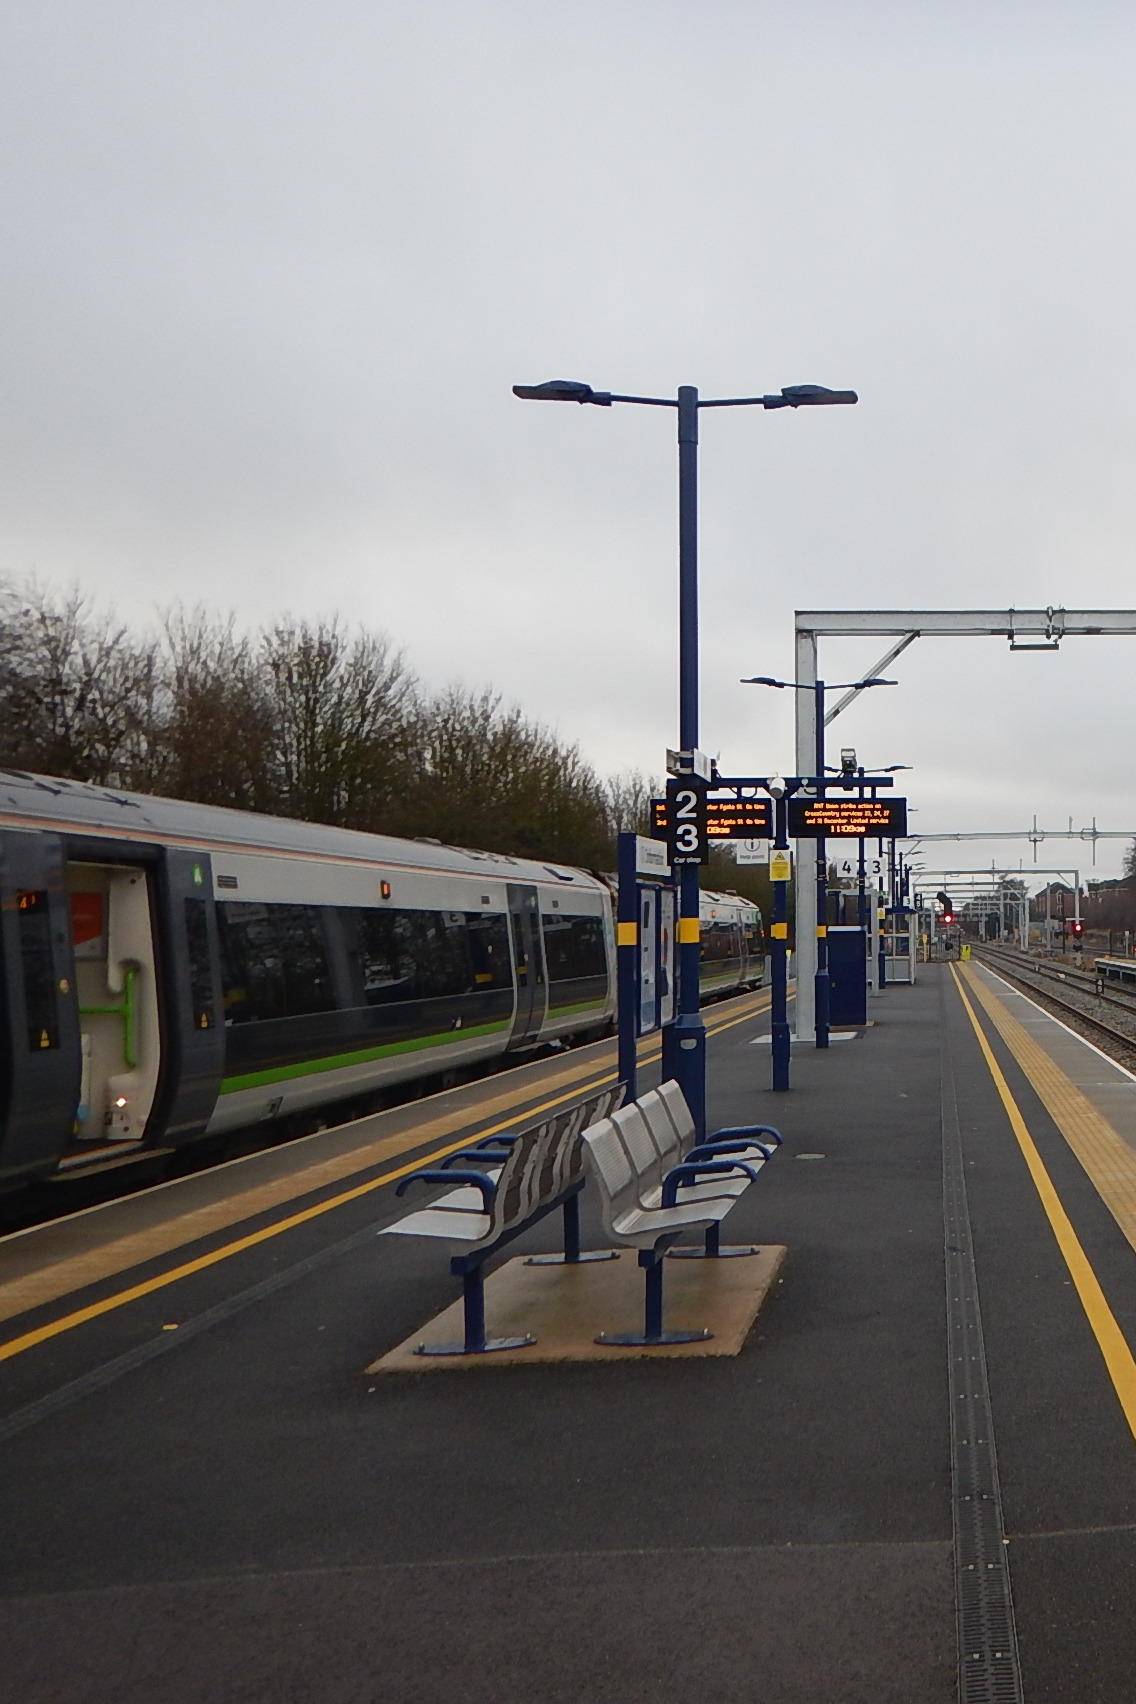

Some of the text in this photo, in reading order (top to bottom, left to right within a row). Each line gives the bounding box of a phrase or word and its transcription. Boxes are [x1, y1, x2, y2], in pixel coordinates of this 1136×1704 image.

[676, 790, 698, 818] 2
[676, 823, 699, 852] 3
[842, 860, 852, 874] 4
[872, 860, 881, 874] 3
